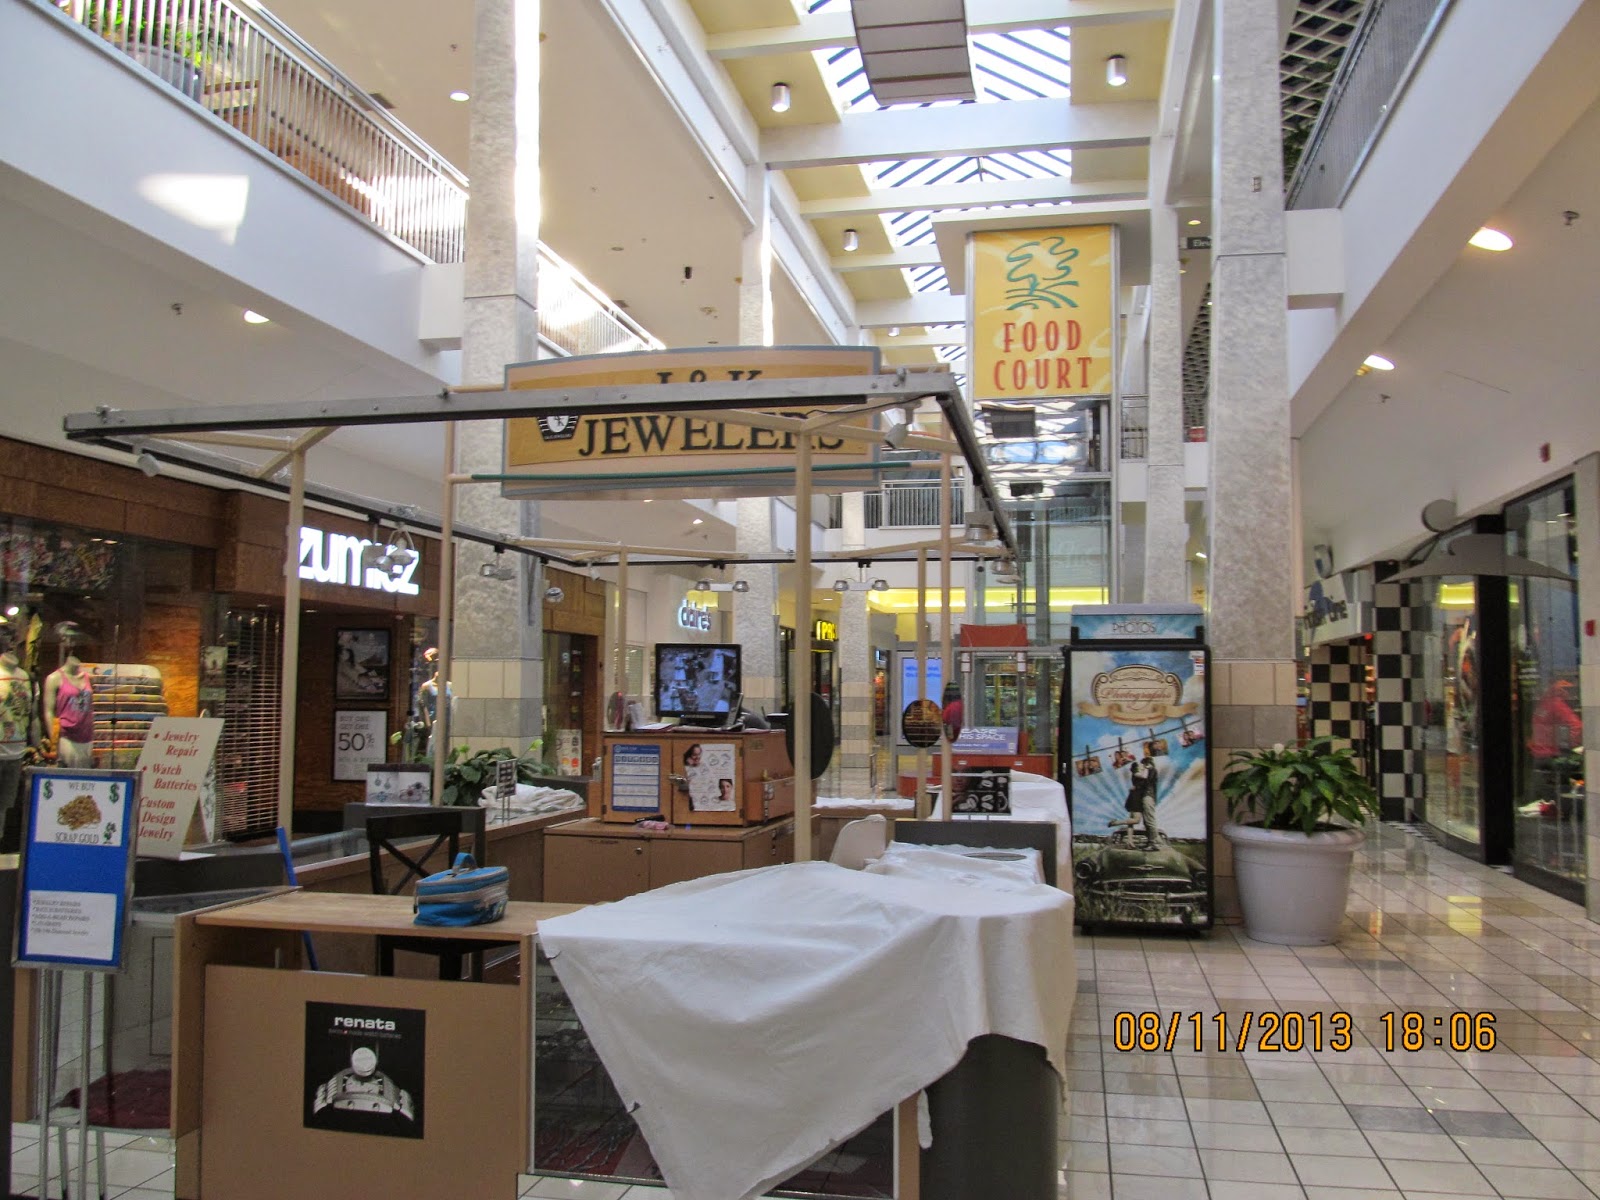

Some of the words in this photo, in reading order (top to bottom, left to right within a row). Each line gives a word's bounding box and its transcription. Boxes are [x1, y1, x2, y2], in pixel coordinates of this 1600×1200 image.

[1003, 319, 1082, 353] FOOD
[993, 356, 1093, 391] COURT
[162, 730, 200, 743] Jewelry
[166, 744, 199, 758] Repair
[152, 763, 182, 775] Watch
[81, 782, 96, 791] BUY
[153, 778, 198, 791] Batteries
[140, 796, 176, 809] Custom
[141, 811, 177, 825] Design
[79, 832, 100, 844] GOLD
[139, 826, 175, 841] Jewelry
[334, 1016, 396, 1031] renata
